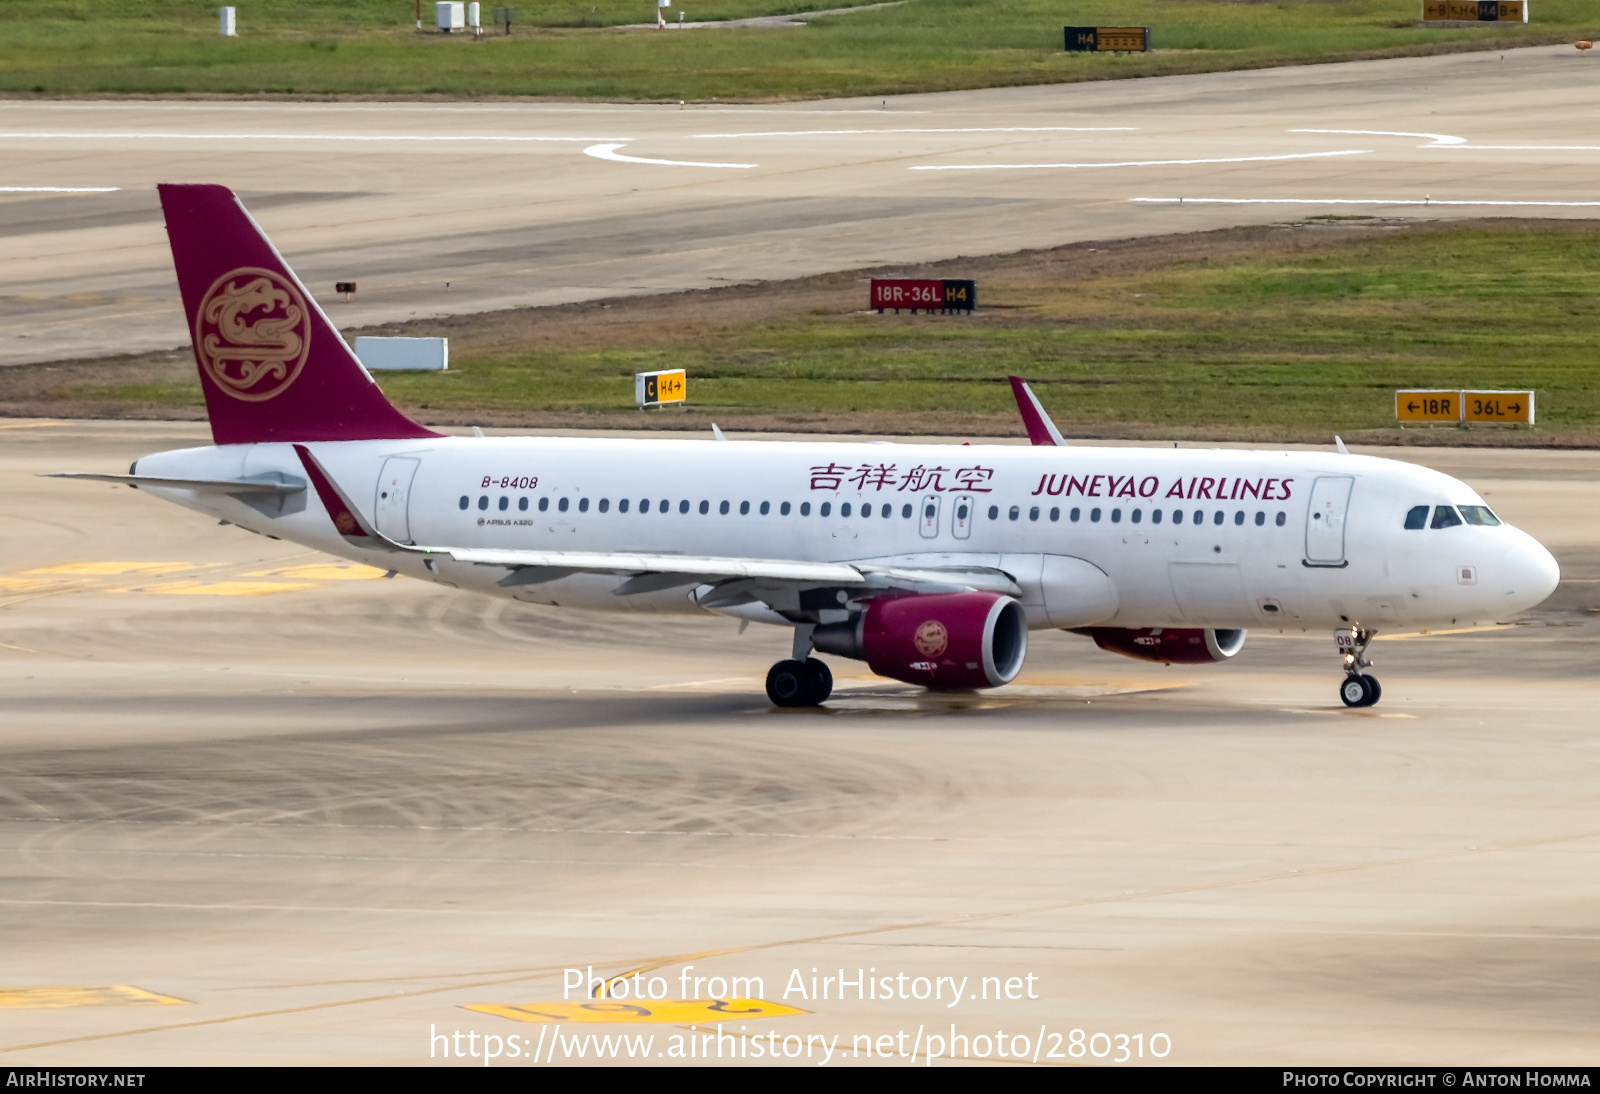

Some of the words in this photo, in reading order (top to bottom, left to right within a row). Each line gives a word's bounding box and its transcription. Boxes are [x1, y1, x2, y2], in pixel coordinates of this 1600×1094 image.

[1438, 4, 1446, 16] B
[1460, 6, 1476, 16] H4
[1480, 6, 1496, 16] H4
[1500, 5, 1508, 16] B
[1077, 33, 1094, 45] H4
[877, 286, 942, 302] 18R-36L
[946, 287, 967, 302] H4
[647, 381, 655, 397] C
[660, 379, 673, 396] H4
[1423, 399, 1451, 415] 18R
[1473, 400, 1505, 416] 36L
[481, 475, 539, 490] B-8408
[809, 462, 994, 493] 吉祥航空
[1031, 474, 1159, 498] JUNEYAO
[1165, 477, 1294, 501] AIRLINES
[513, 519, 534, 527] A320
[1337, 636, 1352, 646] 08
